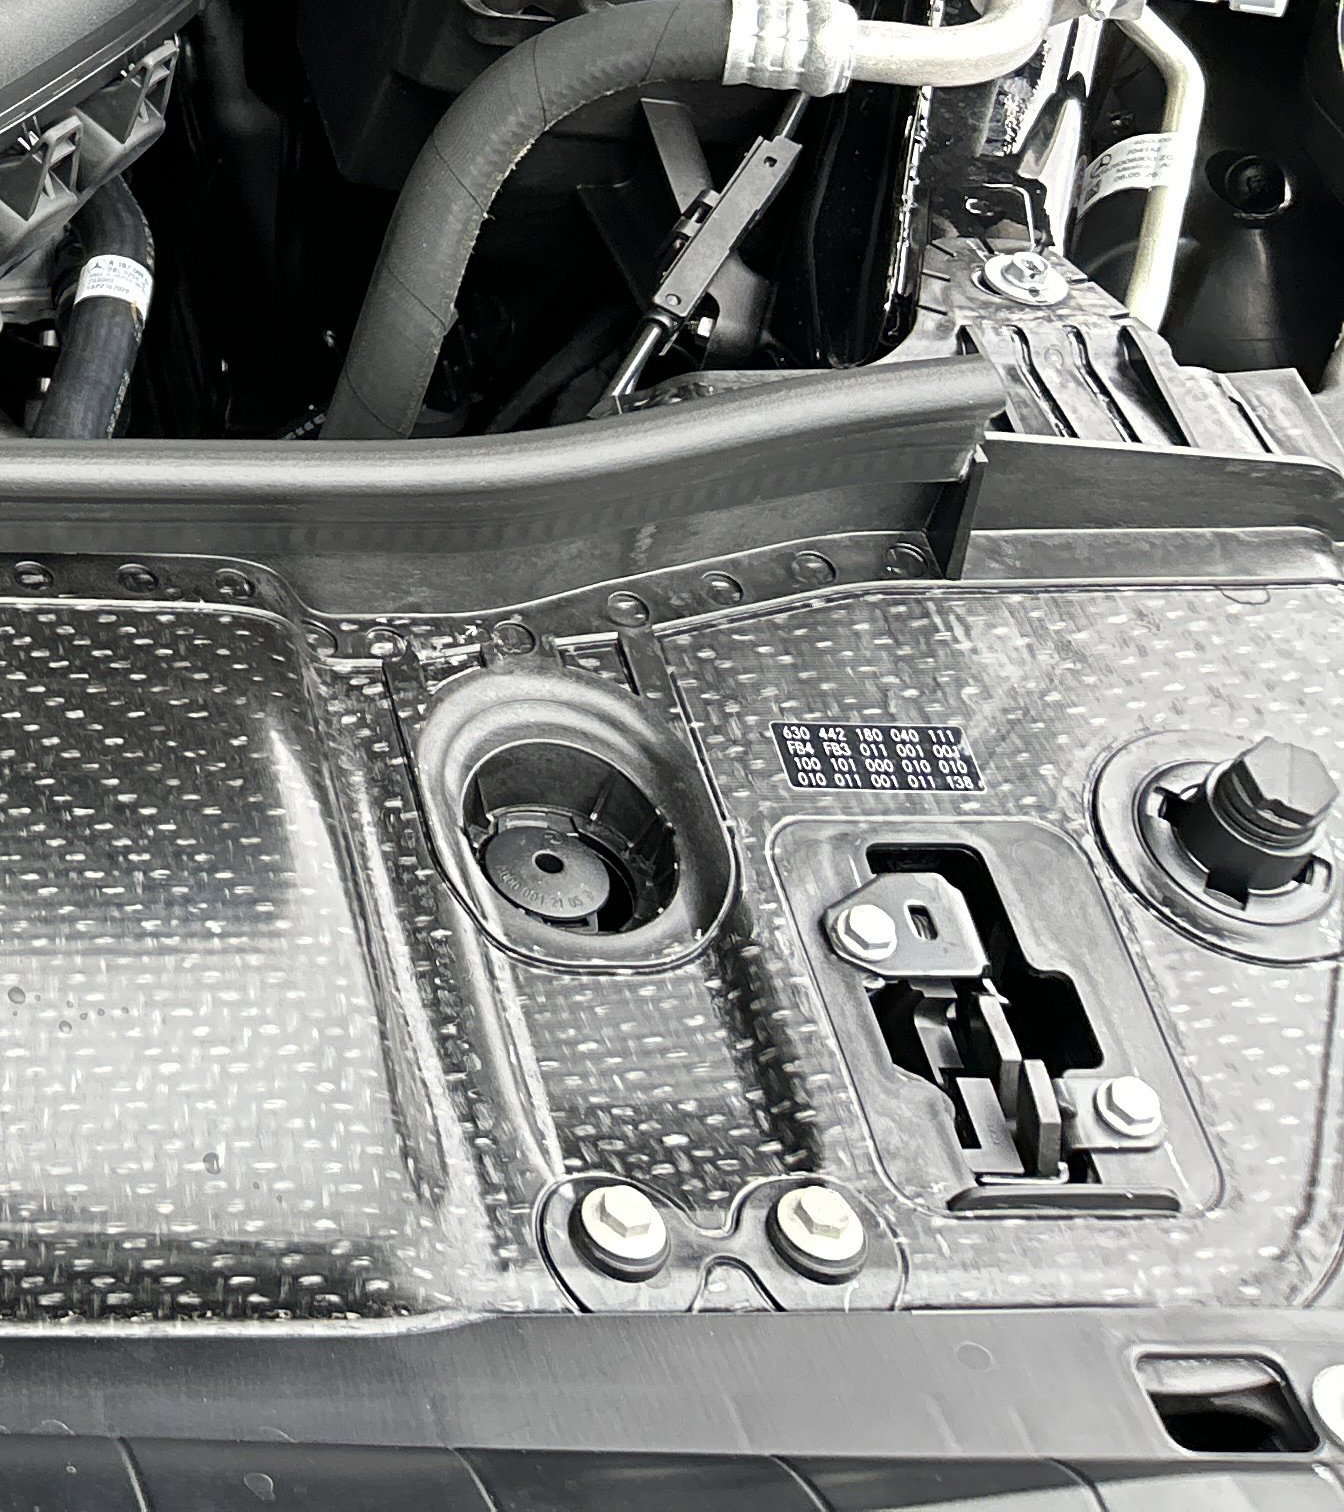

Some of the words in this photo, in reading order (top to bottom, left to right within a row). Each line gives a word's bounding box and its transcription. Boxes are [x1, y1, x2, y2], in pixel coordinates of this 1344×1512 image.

[783, 726, 810, 740] 630
[819, 727, 847, 741] 442
[856, 728, 883, 742] 180
[890, 728, 919, 742] 040
[928, 730, 954, 743] 111
[786, 740, 815, 755] FB4
[823, 741, 852, 756] FB3
[859, 743, 888, 757] 011
[896, 743, 924, 758] 001
[794, 756, 821, 771] 100
[830, 757, 857, 772] 101
[865, 758, 894, 773] 000
[902, 759, 931, 774] 010
[938, 759, 968, 774] 010
[797, 771, 827, 786] 010
[834, 773, 862, 787] 011
[870, 773, 899, 788] 001
[907, 774, 936, 789] 011
[945, 775, 974, 789] 138
